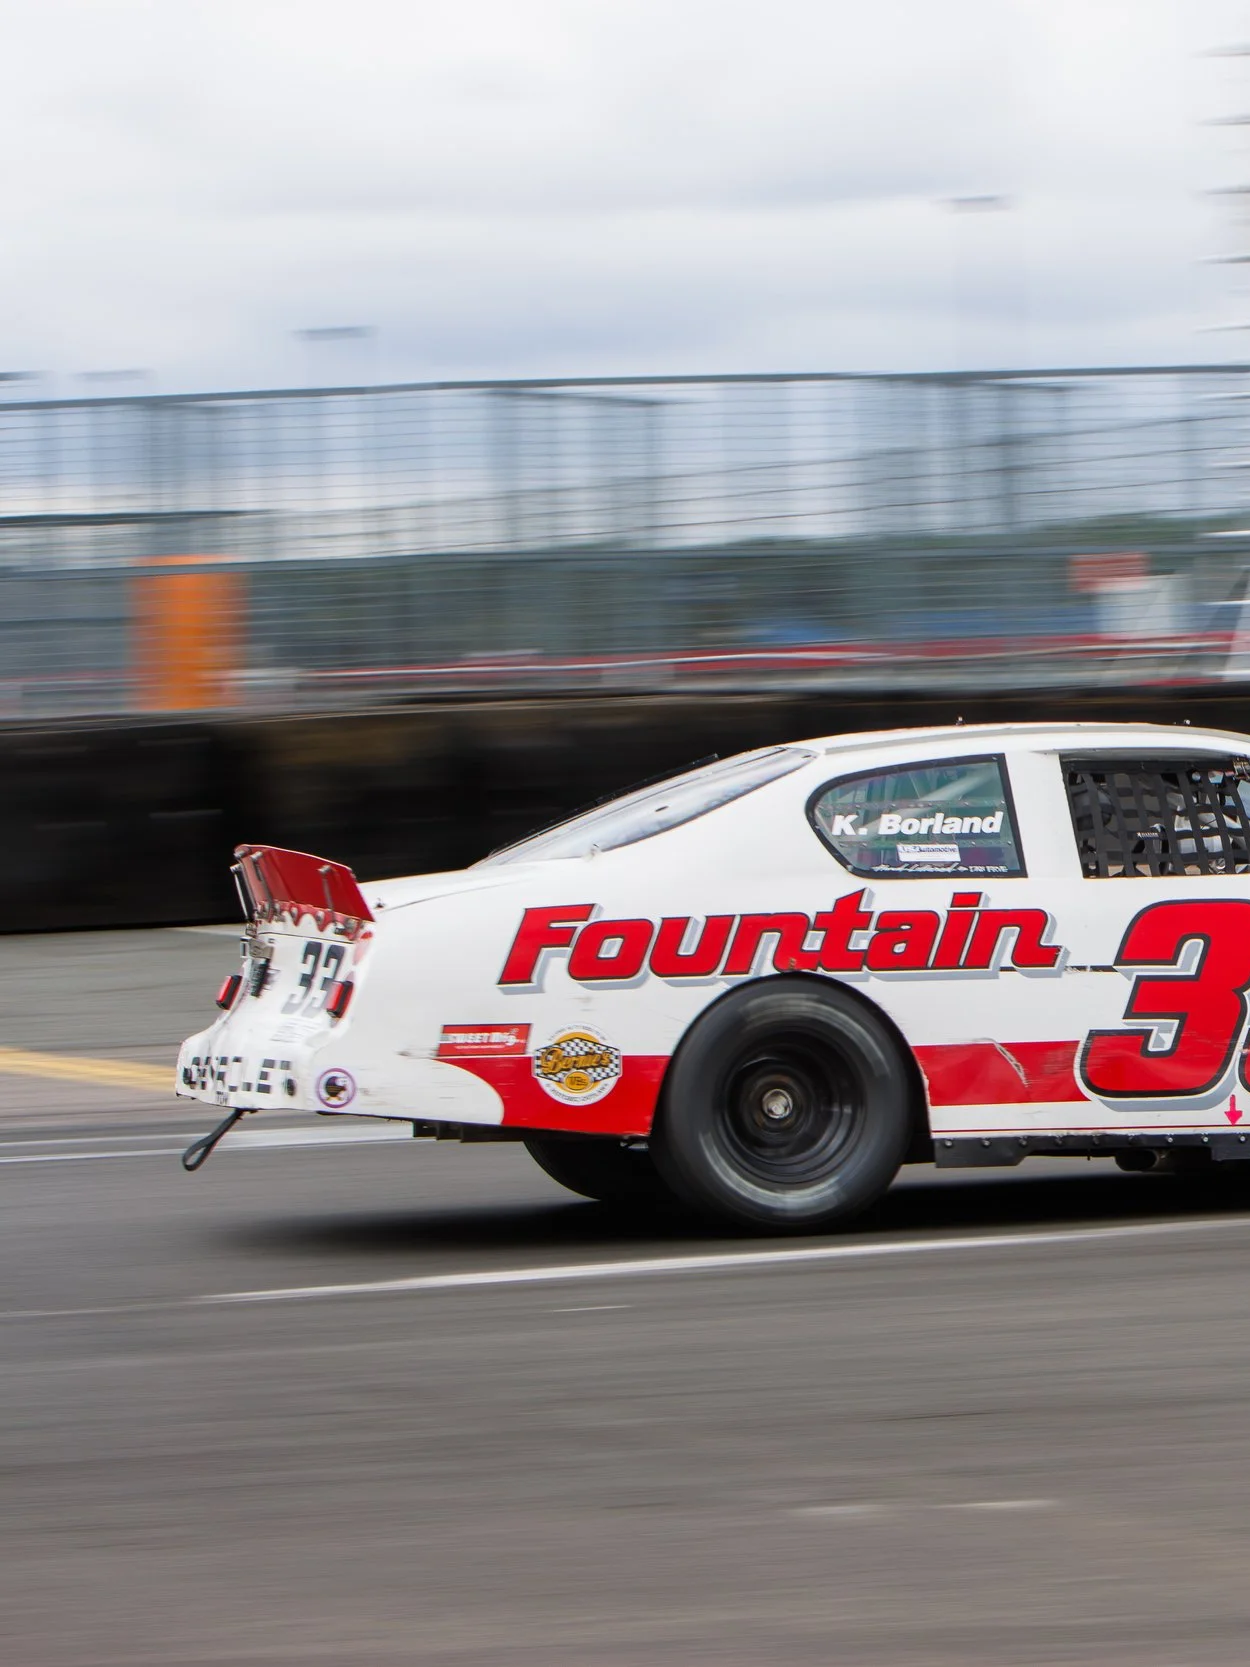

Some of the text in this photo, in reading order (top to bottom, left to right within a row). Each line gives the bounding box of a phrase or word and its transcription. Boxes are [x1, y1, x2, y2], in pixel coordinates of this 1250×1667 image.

[831, 811, 1004, 836] K. Borland
[497, 887, 1060, 987] Fountain
[281, 941, 345, 1019] 33
